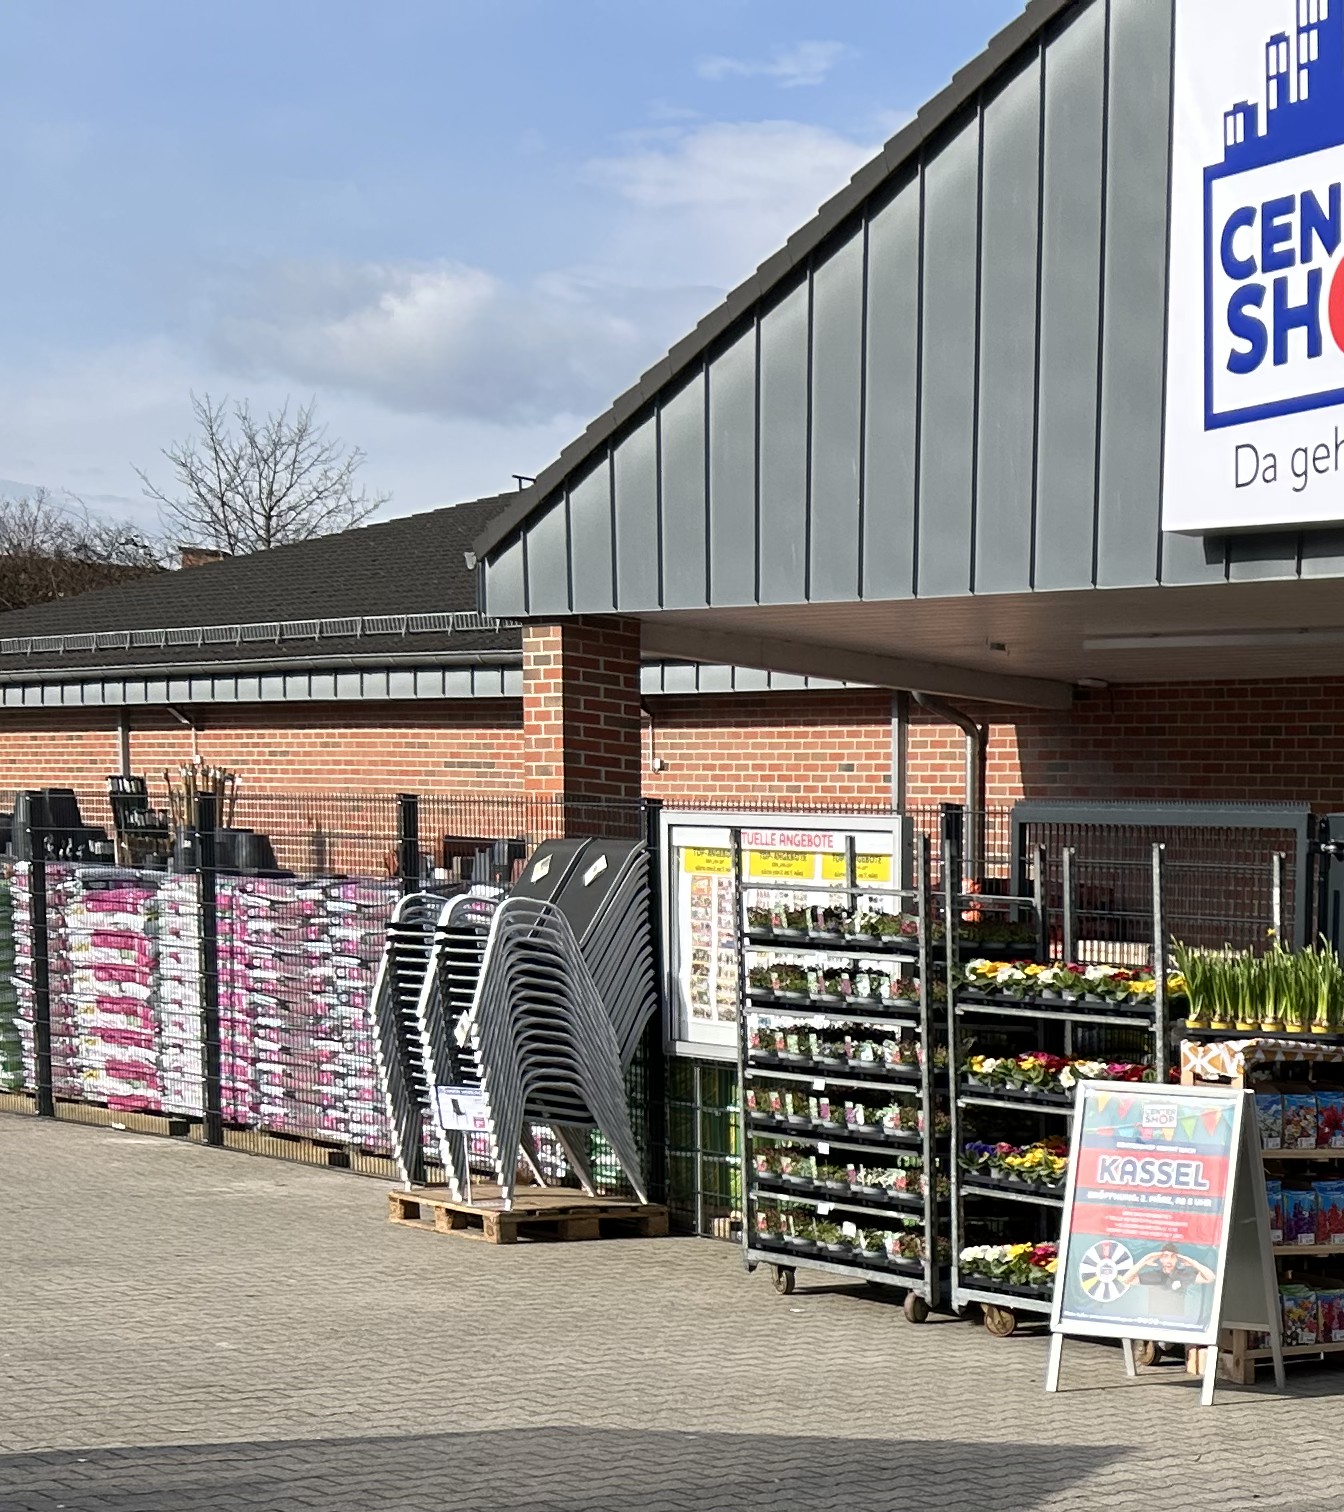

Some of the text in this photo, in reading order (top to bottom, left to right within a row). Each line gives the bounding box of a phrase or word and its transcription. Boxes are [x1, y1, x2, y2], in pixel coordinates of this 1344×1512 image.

[1235, 443, 1278, 489] Da
[741, 831, 833, 849] TUELLE ANGEBOTE
[1145, 1114, 1175, 1125] SHOP
[1098, 1157, 1208, 1189] KASSEL
